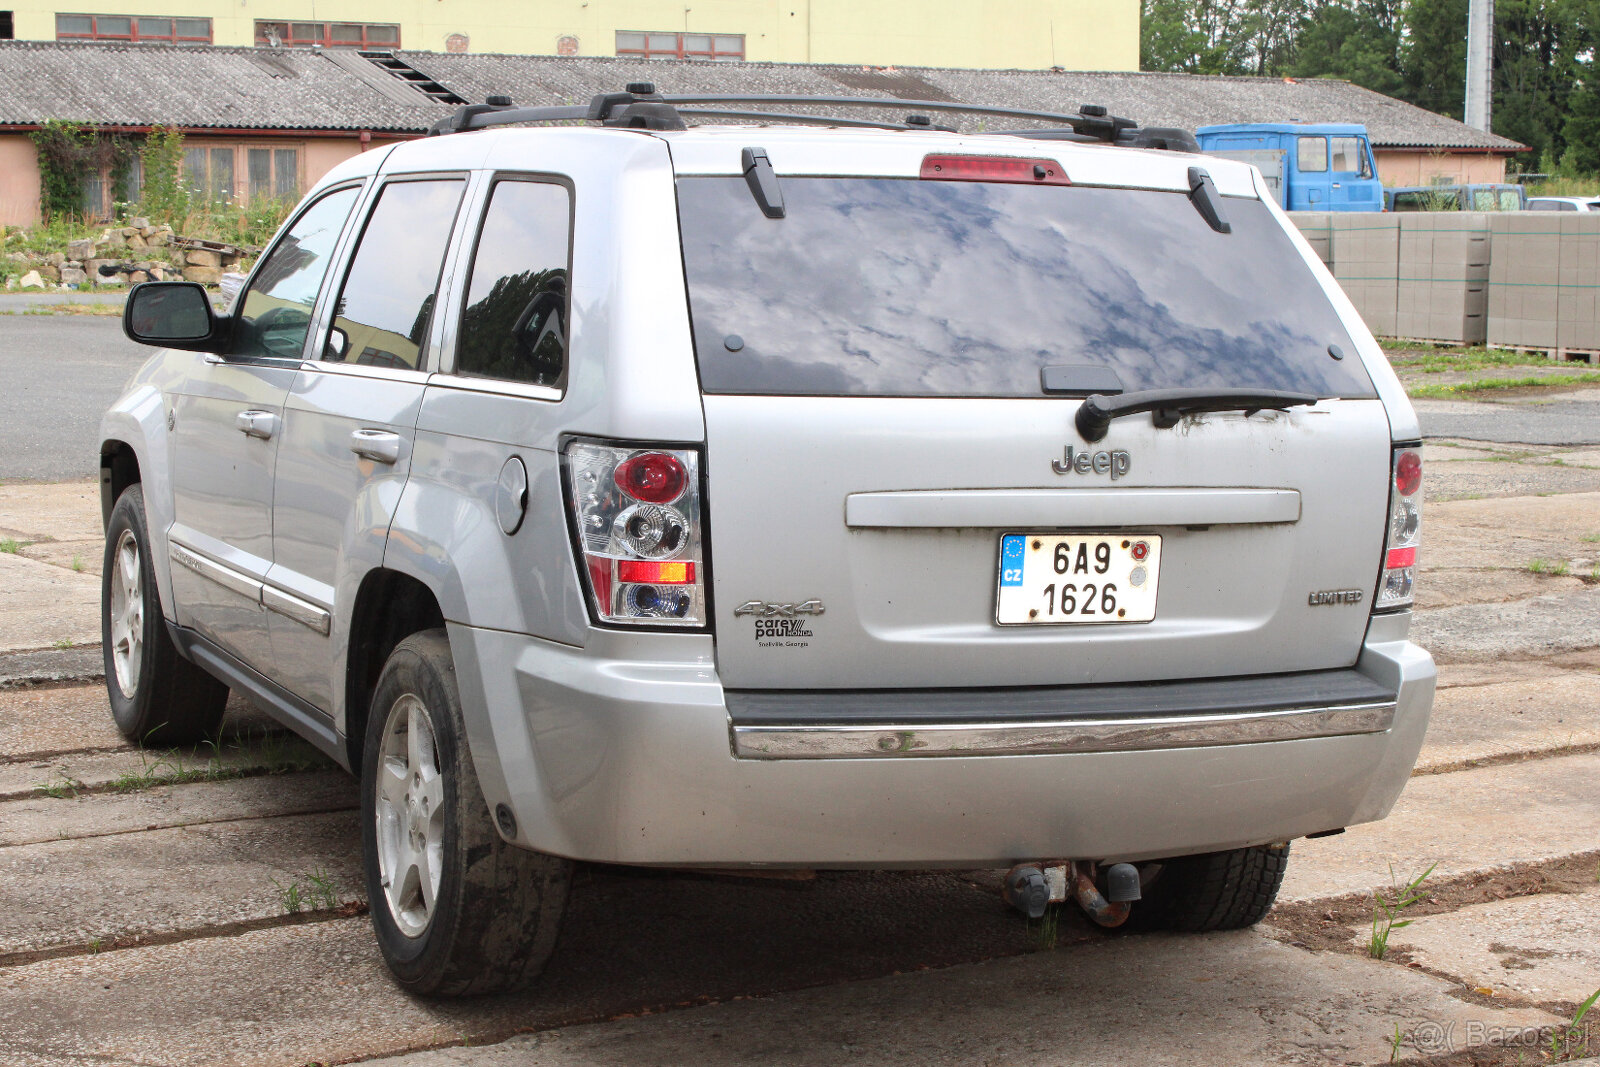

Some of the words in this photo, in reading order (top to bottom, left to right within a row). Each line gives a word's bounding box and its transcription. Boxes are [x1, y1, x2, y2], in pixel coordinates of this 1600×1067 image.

[1052, 445, 1131, 480] Jeep
[1054, 542, 1111, 574] 6A9
[1004, 569, 1022, 581] CZ
[1043, 583, 1117, 615] 1626
[1308, 590, 1363, 606] LIMITED
[755, 619, 798, 632] carey
[755, 627, 788, 640] paul
